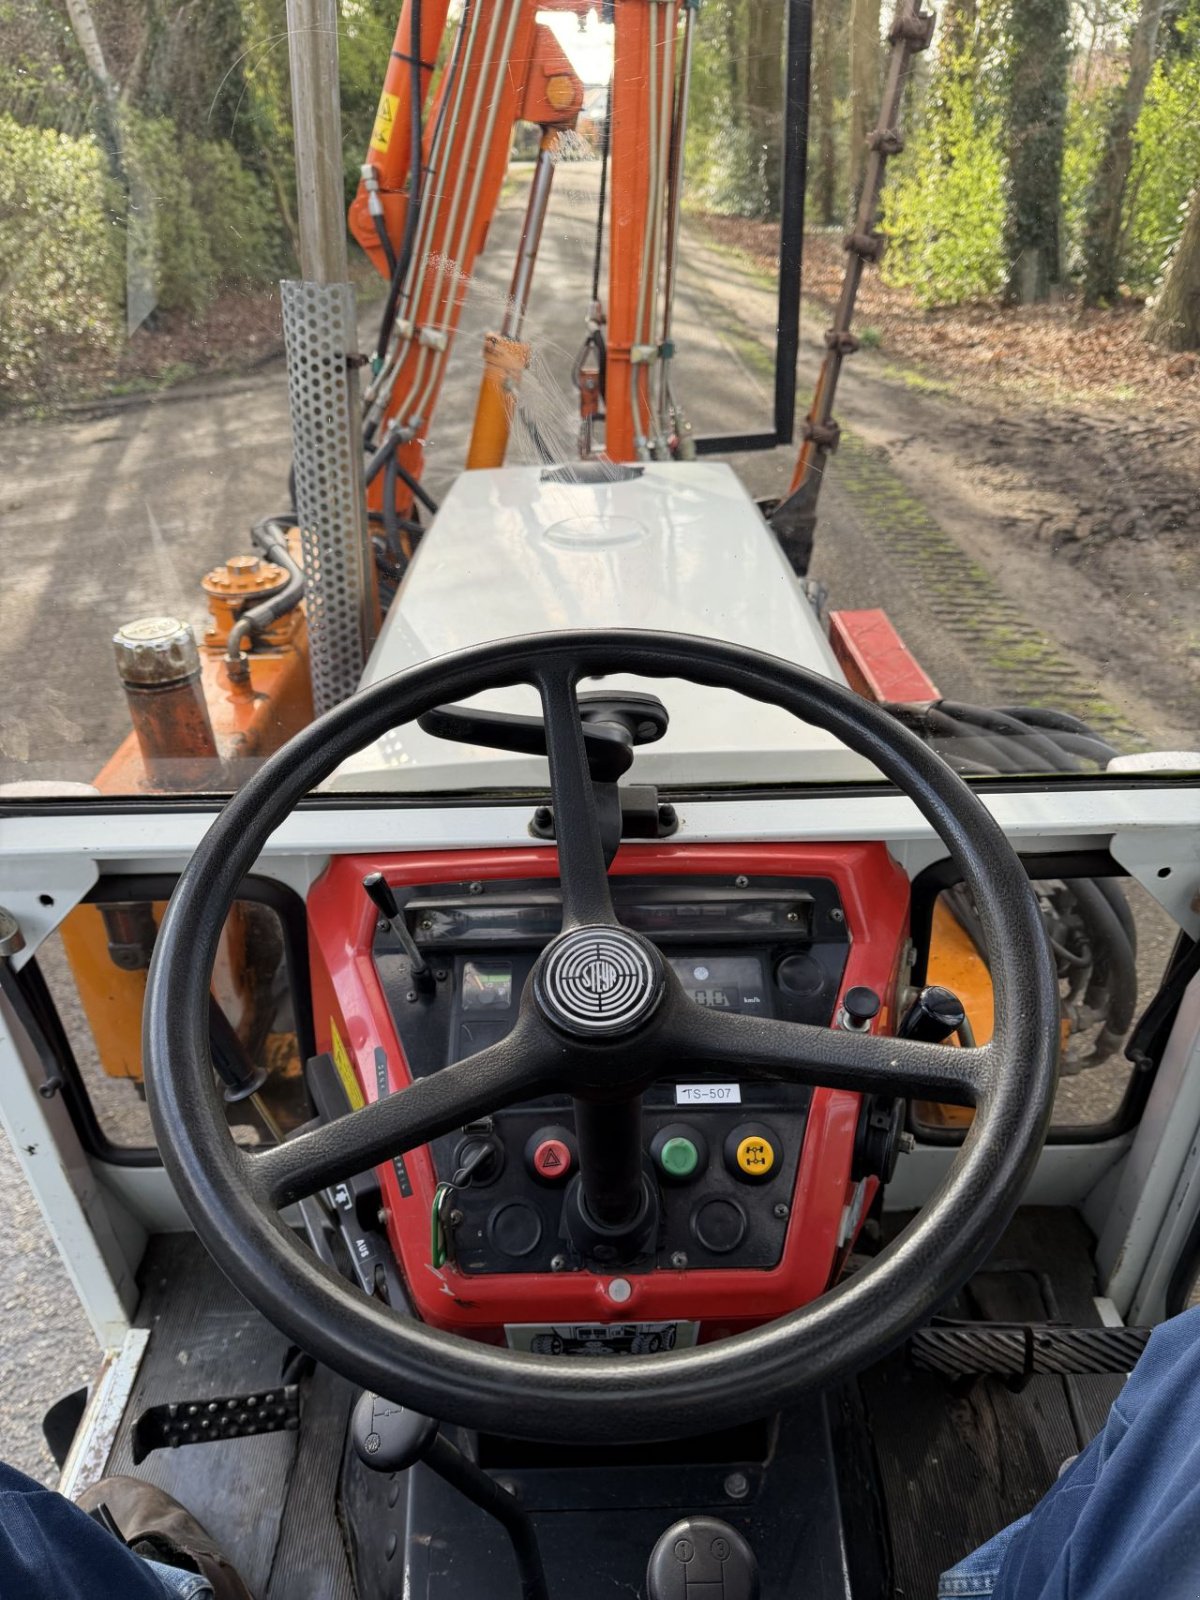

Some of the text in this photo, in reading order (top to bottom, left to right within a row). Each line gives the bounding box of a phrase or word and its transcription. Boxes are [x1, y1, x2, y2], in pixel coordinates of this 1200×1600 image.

[582, 961, 617, 993] STEYR
[684, 1088, 732, 1099] TS-507
[355, 1239, 370, 1258] AUS
